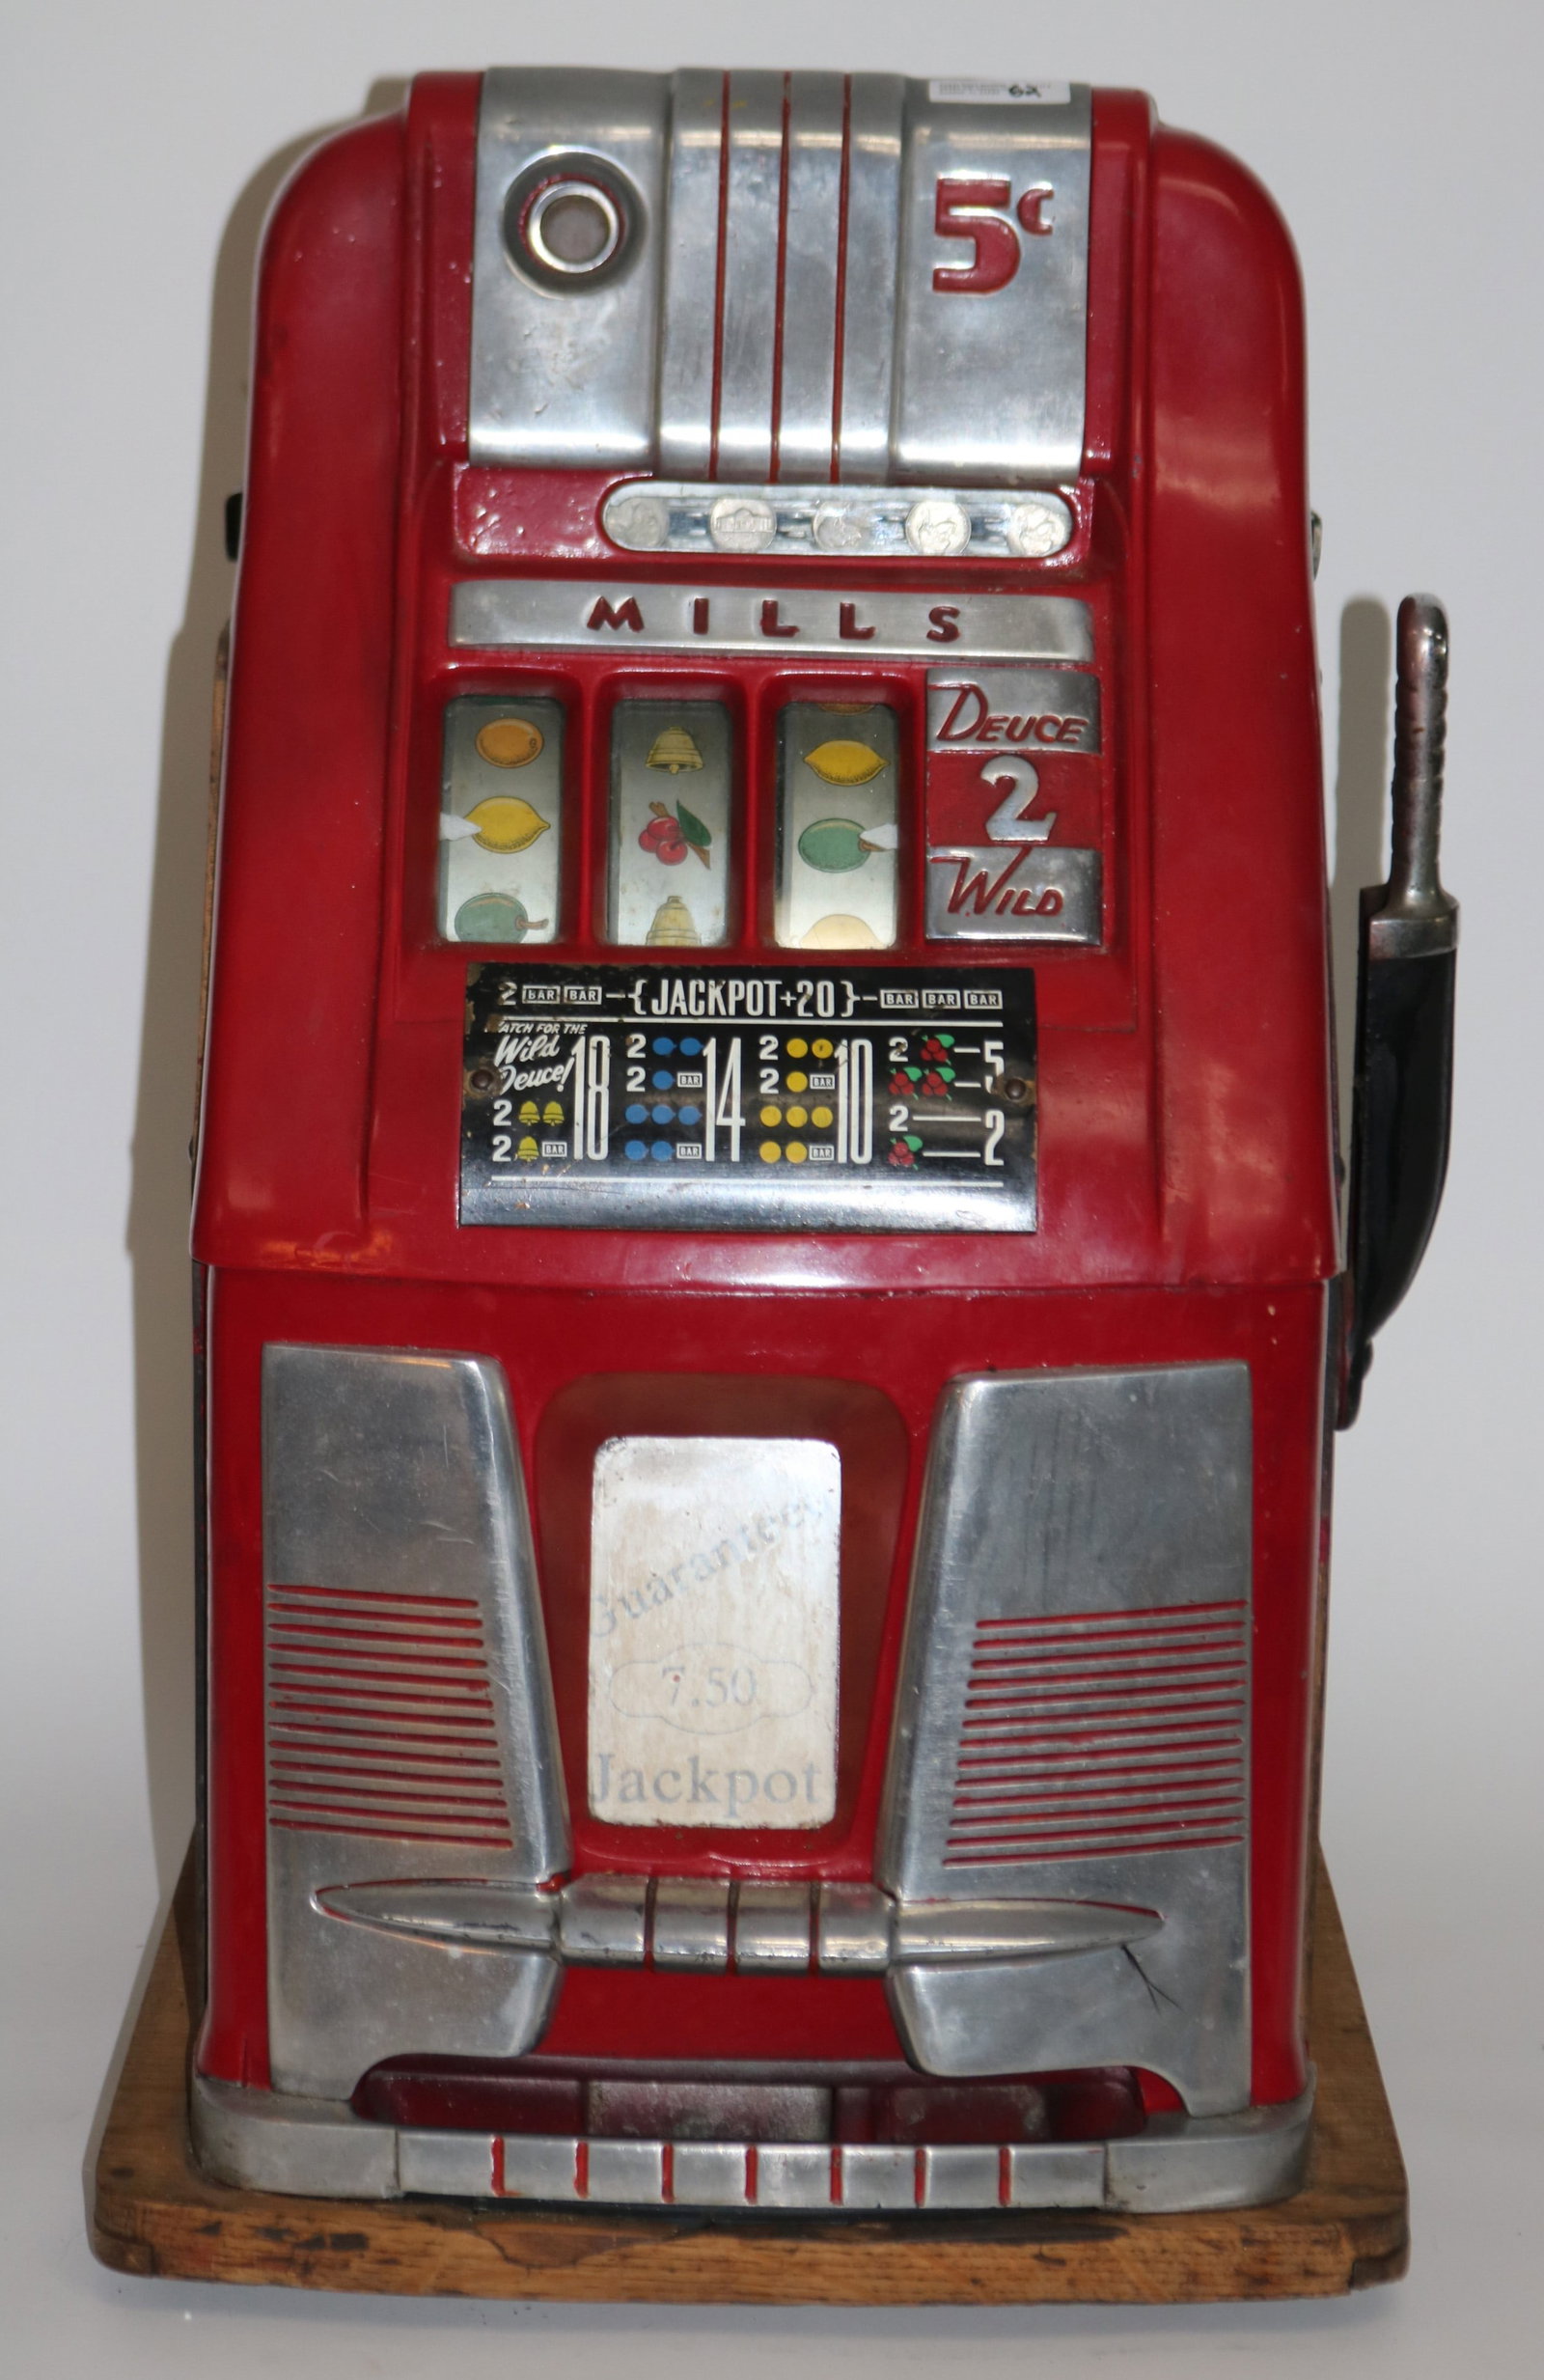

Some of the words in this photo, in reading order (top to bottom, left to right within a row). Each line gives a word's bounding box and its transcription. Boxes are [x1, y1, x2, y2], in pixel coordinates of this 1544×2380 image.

[586, 595, 961, 643] MILLS
[980, 753, 1058, 843] 2
[526, 986, 557, 1002] BAR
[567, 987, 598, 1002] BAR
[885, 990, 915, 1005] BAR
[926, 991, 956, 1006] BAR
[969, 991, 999, 1006] BAR
[484, 1022, 533, 1034] ATCH
[536, 1023, 561, 1034] FOR
[564, 1024, 588, 1035] THE
[494, 1034, 561, 1067] Wild
[627, 1033, 647, 1059] 2
[758, 1035, 779, 1061] 2
[889, 1037, 909, 1062] 2
[626, 1065, 647, 1093] 2
[679, 1073, 701, 1086] BAR
[758, 1067, 780, 1093] 2
[811, 1075, 833, 1088] BAR
[570, 1035, 611, 1161] 18
[703, 1037, 746, 1162] 14
[834, 1038, 873, 1164] 10
[492, 1099, 512, 1126] 2
[491, 1135, 512, 1162] 2
[544, 1143, 565, 1155] BAR
[889, 1105, 909, 1131] 2
[984, 1109, 1006, 1166] 2
[679, 1145, 701, 1157] BAR
[810, 1146, 832, 1158] BAR
[661, 1666, 758, 1708] 7.50
[592, 1754, 821, 1818] Jackpot
